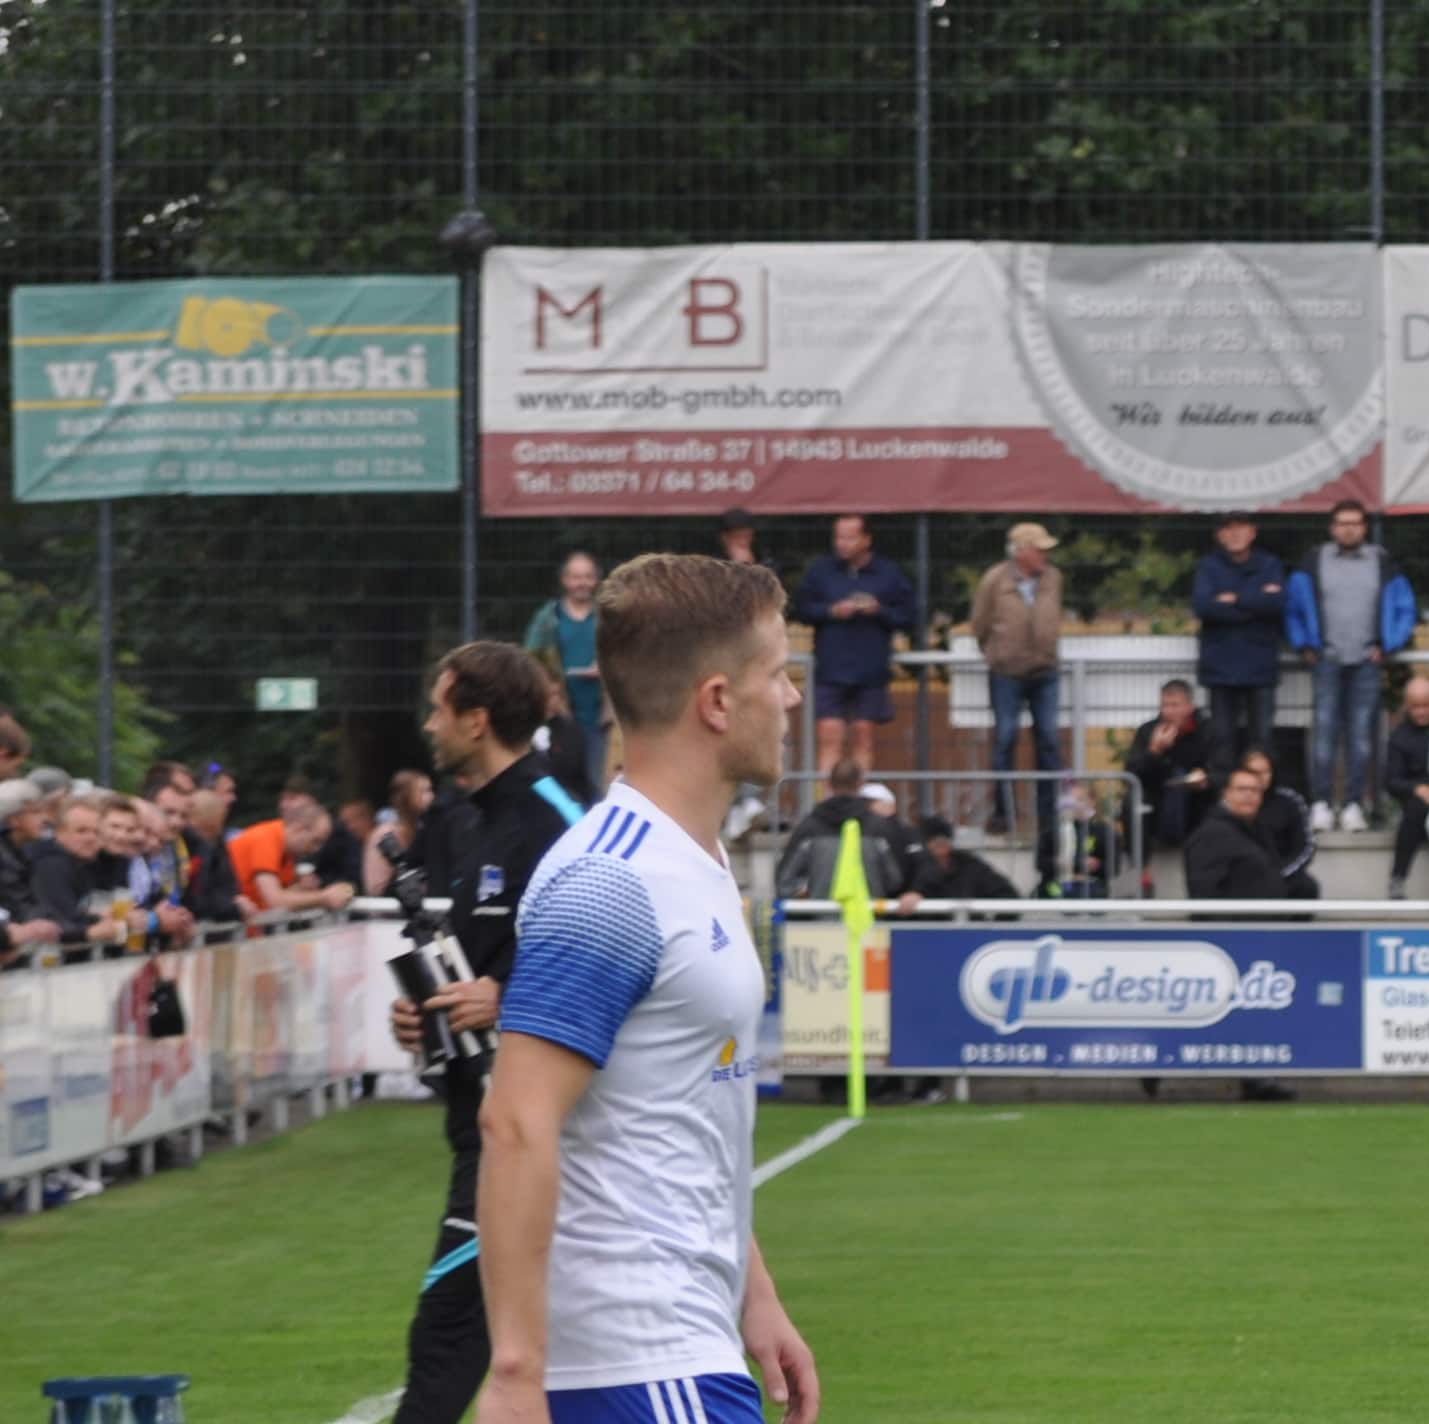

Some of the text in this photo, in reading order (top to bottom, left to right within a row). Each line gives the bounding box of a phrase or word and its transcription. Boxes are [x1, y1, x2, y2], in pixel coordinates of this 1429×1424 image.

[516, 385, 843, 414] www.mob-gmbh.com
[1111, 402, 1162, 426] Wir
[1178, 402, 1257, 426] bilden
[847, 436, 1008, 460] Luckenwalde
[962, 1044, 1293, 1064] DESIGN MEDIEN WERBUNG
